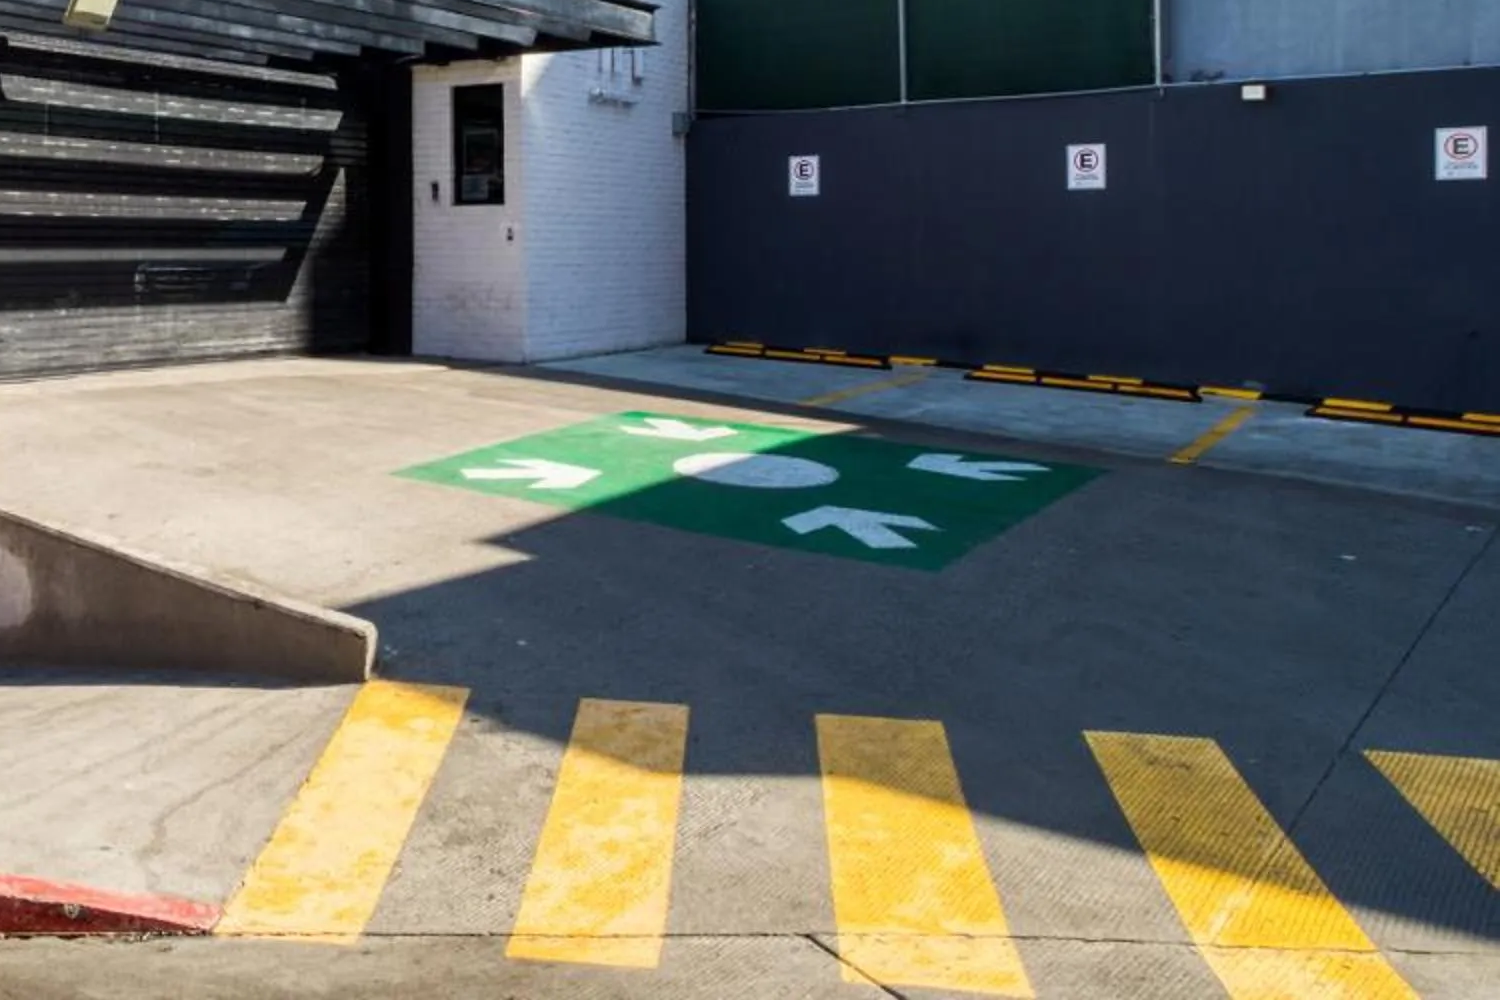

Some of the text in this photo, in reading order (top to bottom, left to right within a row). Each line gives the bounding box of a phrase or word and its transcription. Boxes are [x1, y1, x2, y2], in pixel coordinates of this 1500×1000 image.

[1453, 138, 1468, 154] E
[1080, 153, 1092, 168] E
[800, 163, 809, 176] E
